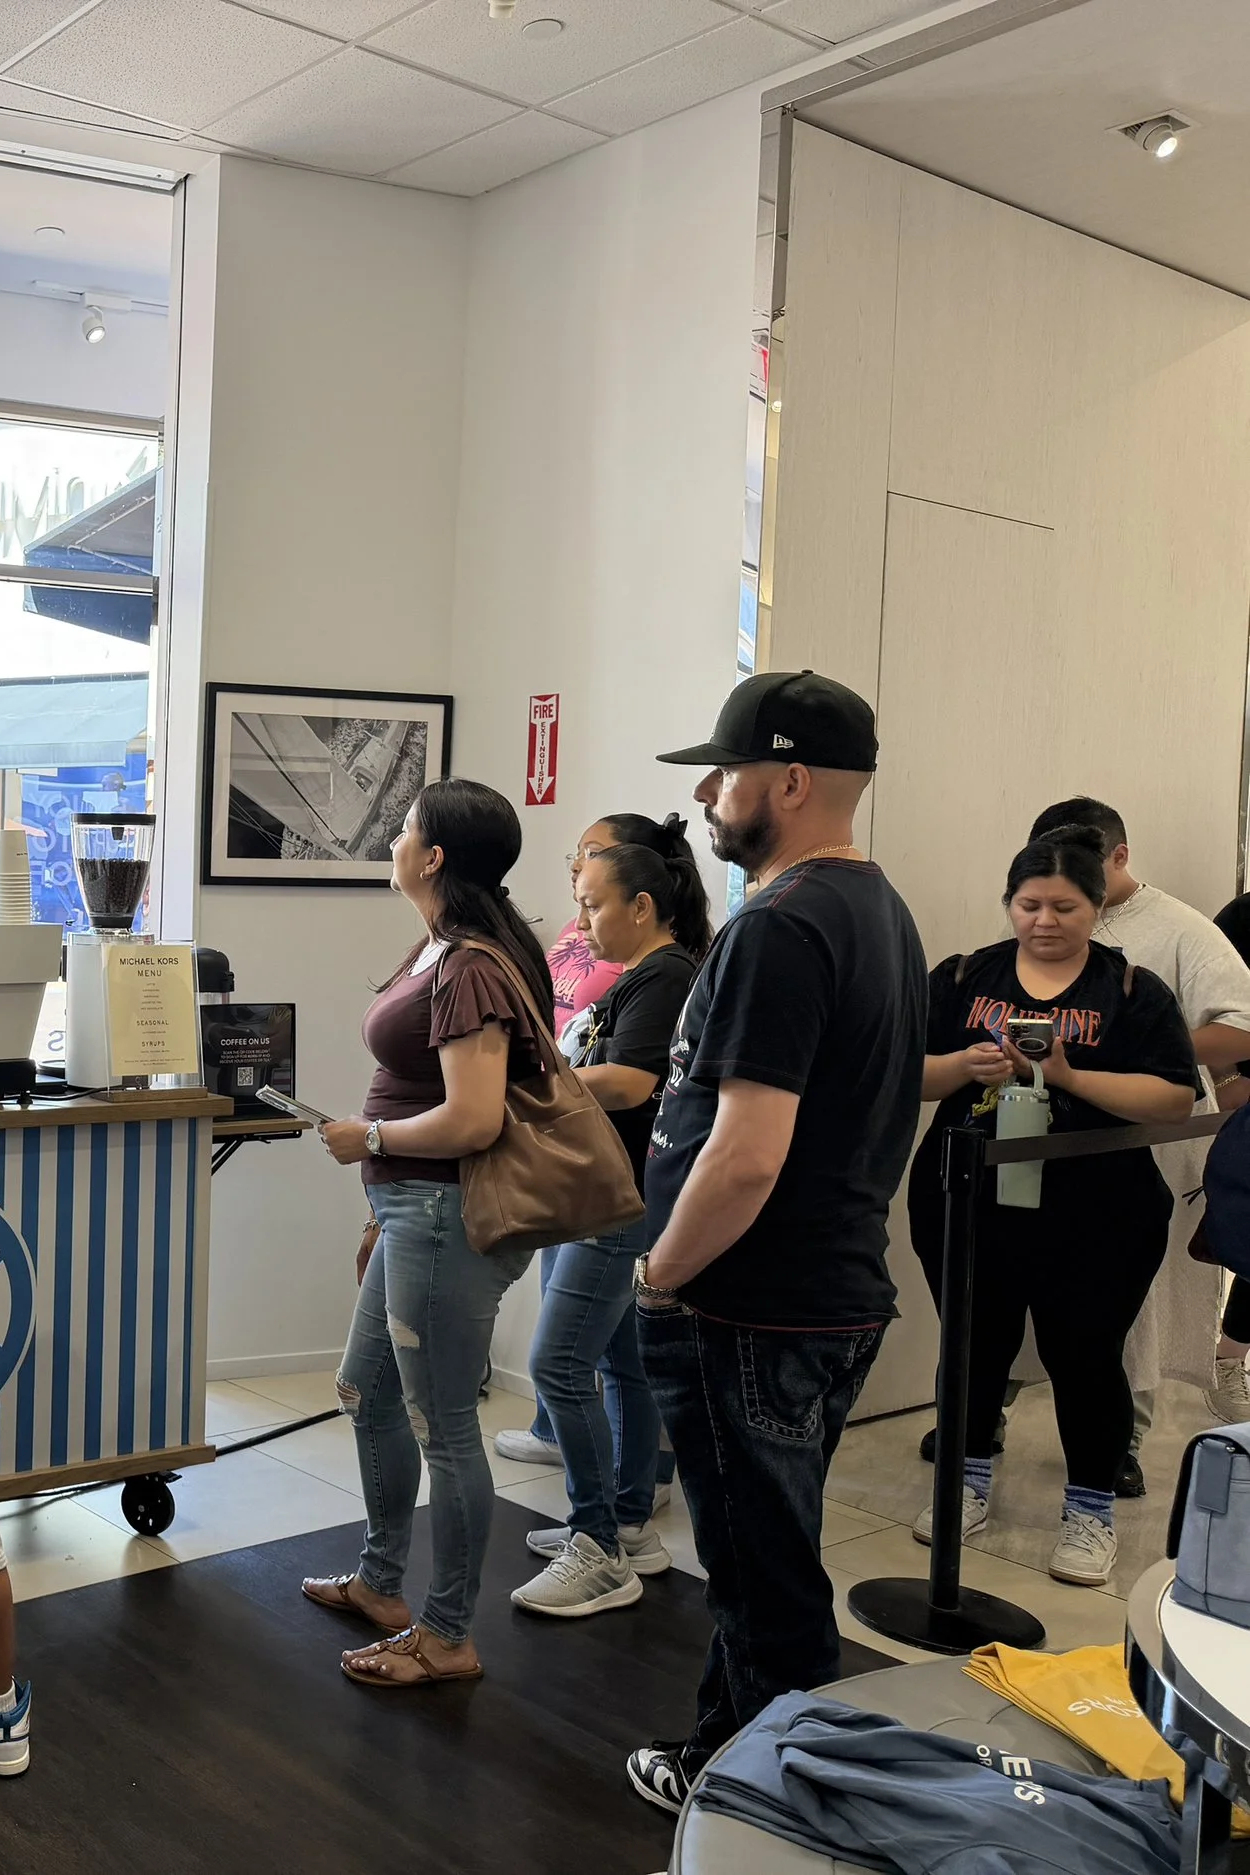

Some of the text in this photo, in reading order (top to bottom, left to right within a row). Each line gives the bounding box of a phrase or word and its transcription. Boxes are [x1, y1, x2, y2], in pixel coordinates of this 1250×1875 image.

[533, 703, 554, 719] FIRE
[536, 721, 546, 795] EXTINGUISHER
[119, 957, 179, 966] MICHAEL KORS
[220, 1038, 247, 1046] COFFEE
[260, 1037, 270, 1045] US
